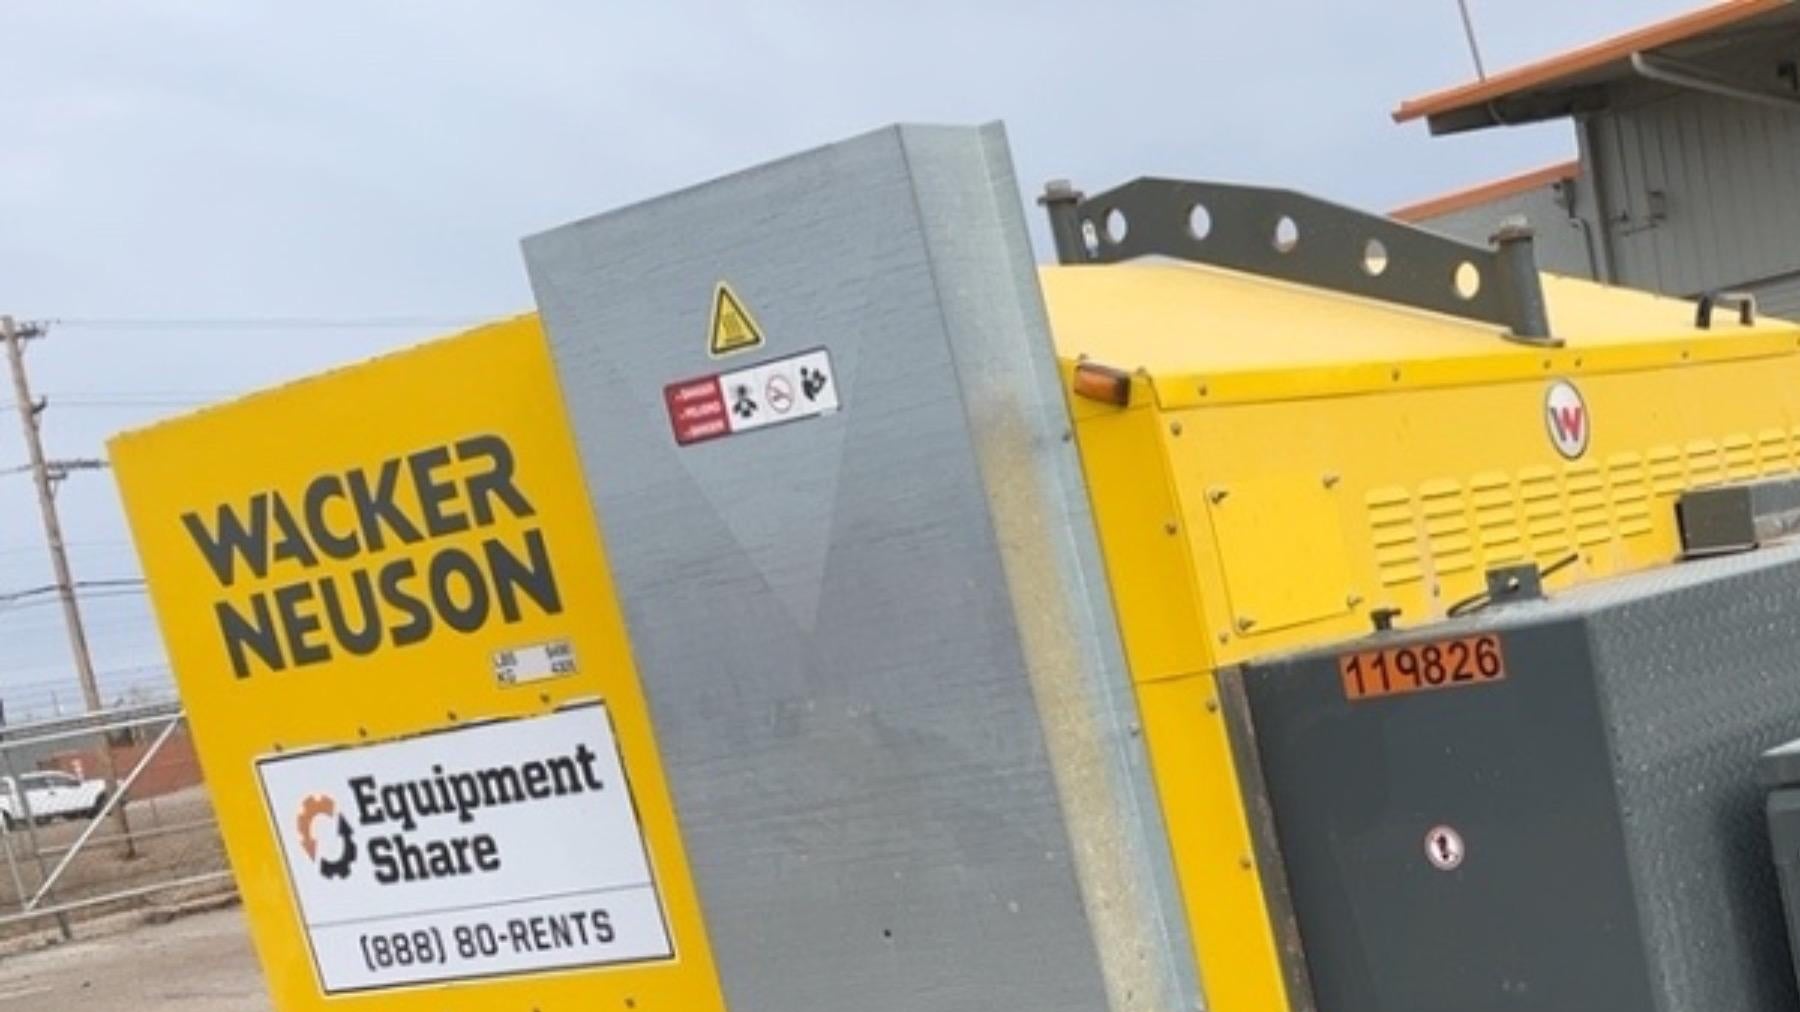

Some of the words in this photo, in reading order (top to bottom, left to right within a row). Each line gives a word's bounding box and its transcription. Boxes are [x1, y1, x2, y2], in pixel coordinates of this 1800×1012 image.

[180, 434, 536, 588] WACKER
[214, 528, 563, 679] NEUSON
[1346, 637, 1500, 694] 119826
[349, 743, 604, 831] Equipment
[367, 834, 501, 885] Share
[360, 926, 447, 972] (888)
[454, 909, 616, 959] 80-RENTS
